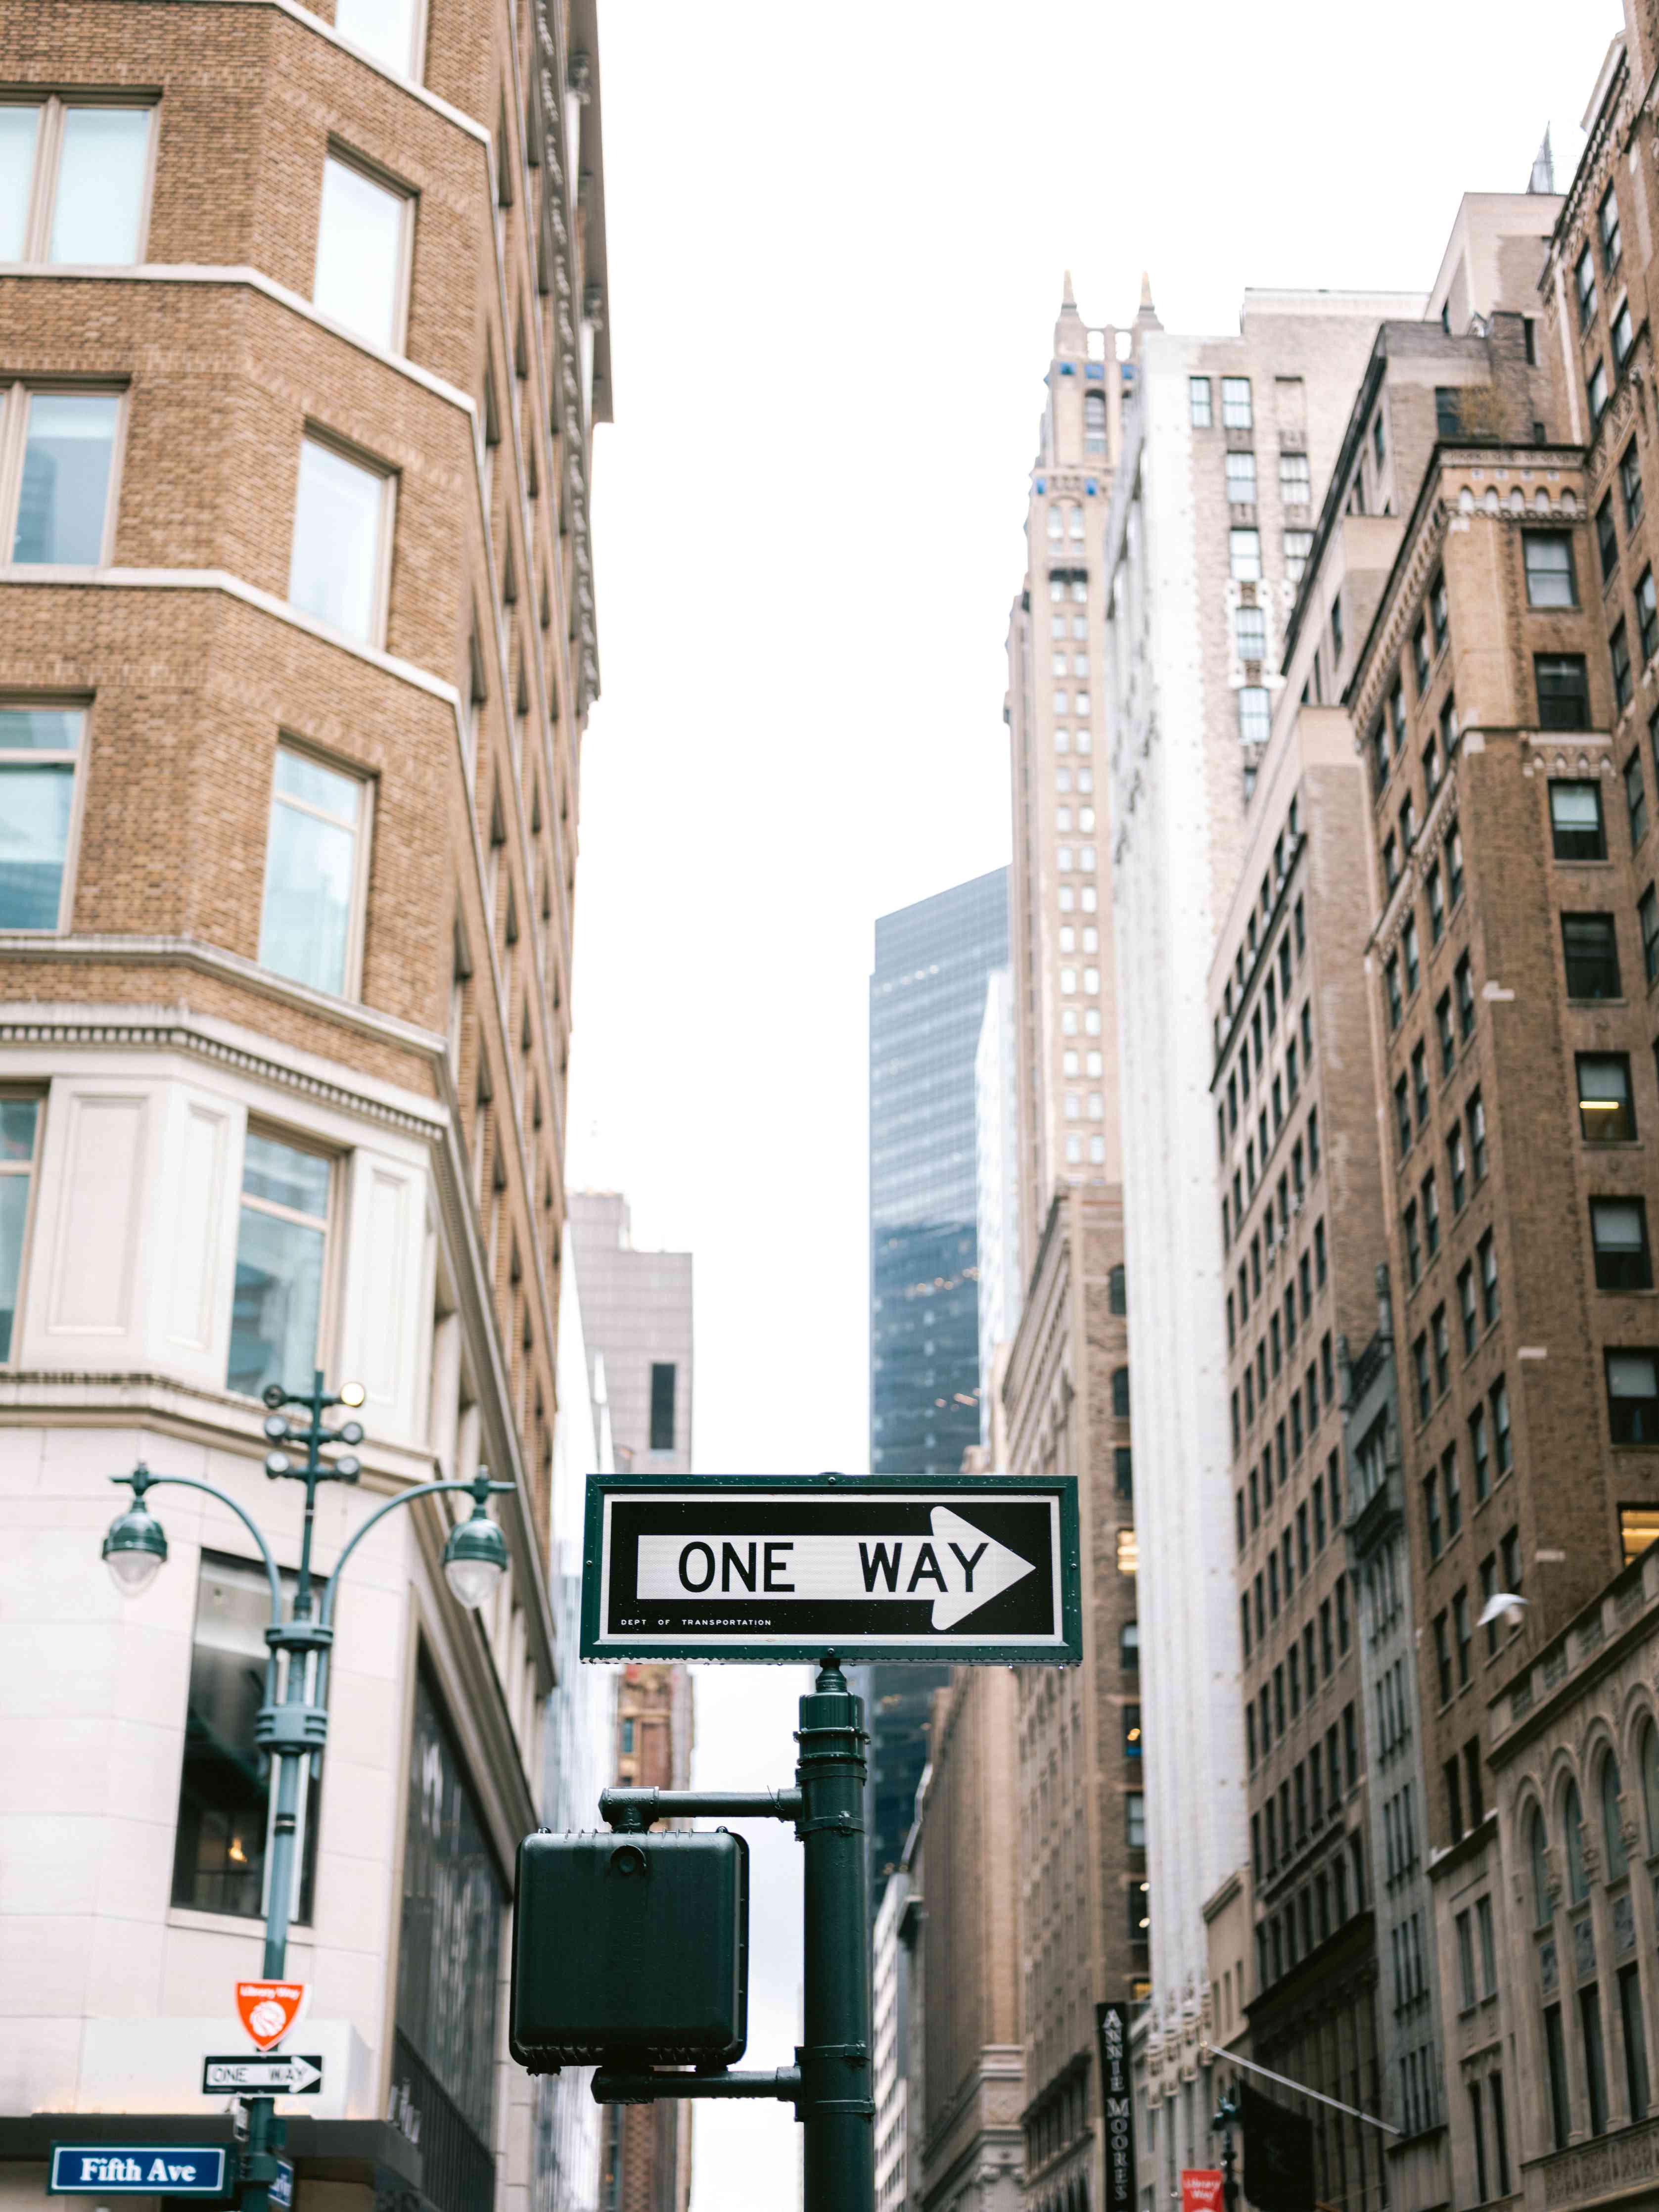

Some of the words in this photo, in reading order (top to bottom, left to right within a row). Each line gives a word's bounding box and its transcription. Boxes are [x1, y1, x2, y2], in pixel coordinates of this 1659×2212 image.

[679, 1541, 795, 1593] ONE
[858, 1542, 989, 1593] WAY
[1103, 2009, 1124, 2091] ANNIE
[213, 2068, 247, 2082] ONE
[269, 2067, 307, 2081] WAY
[80, 2158, 142, 2181] Fifth
[147, 2158, 196, 2182] Ave
